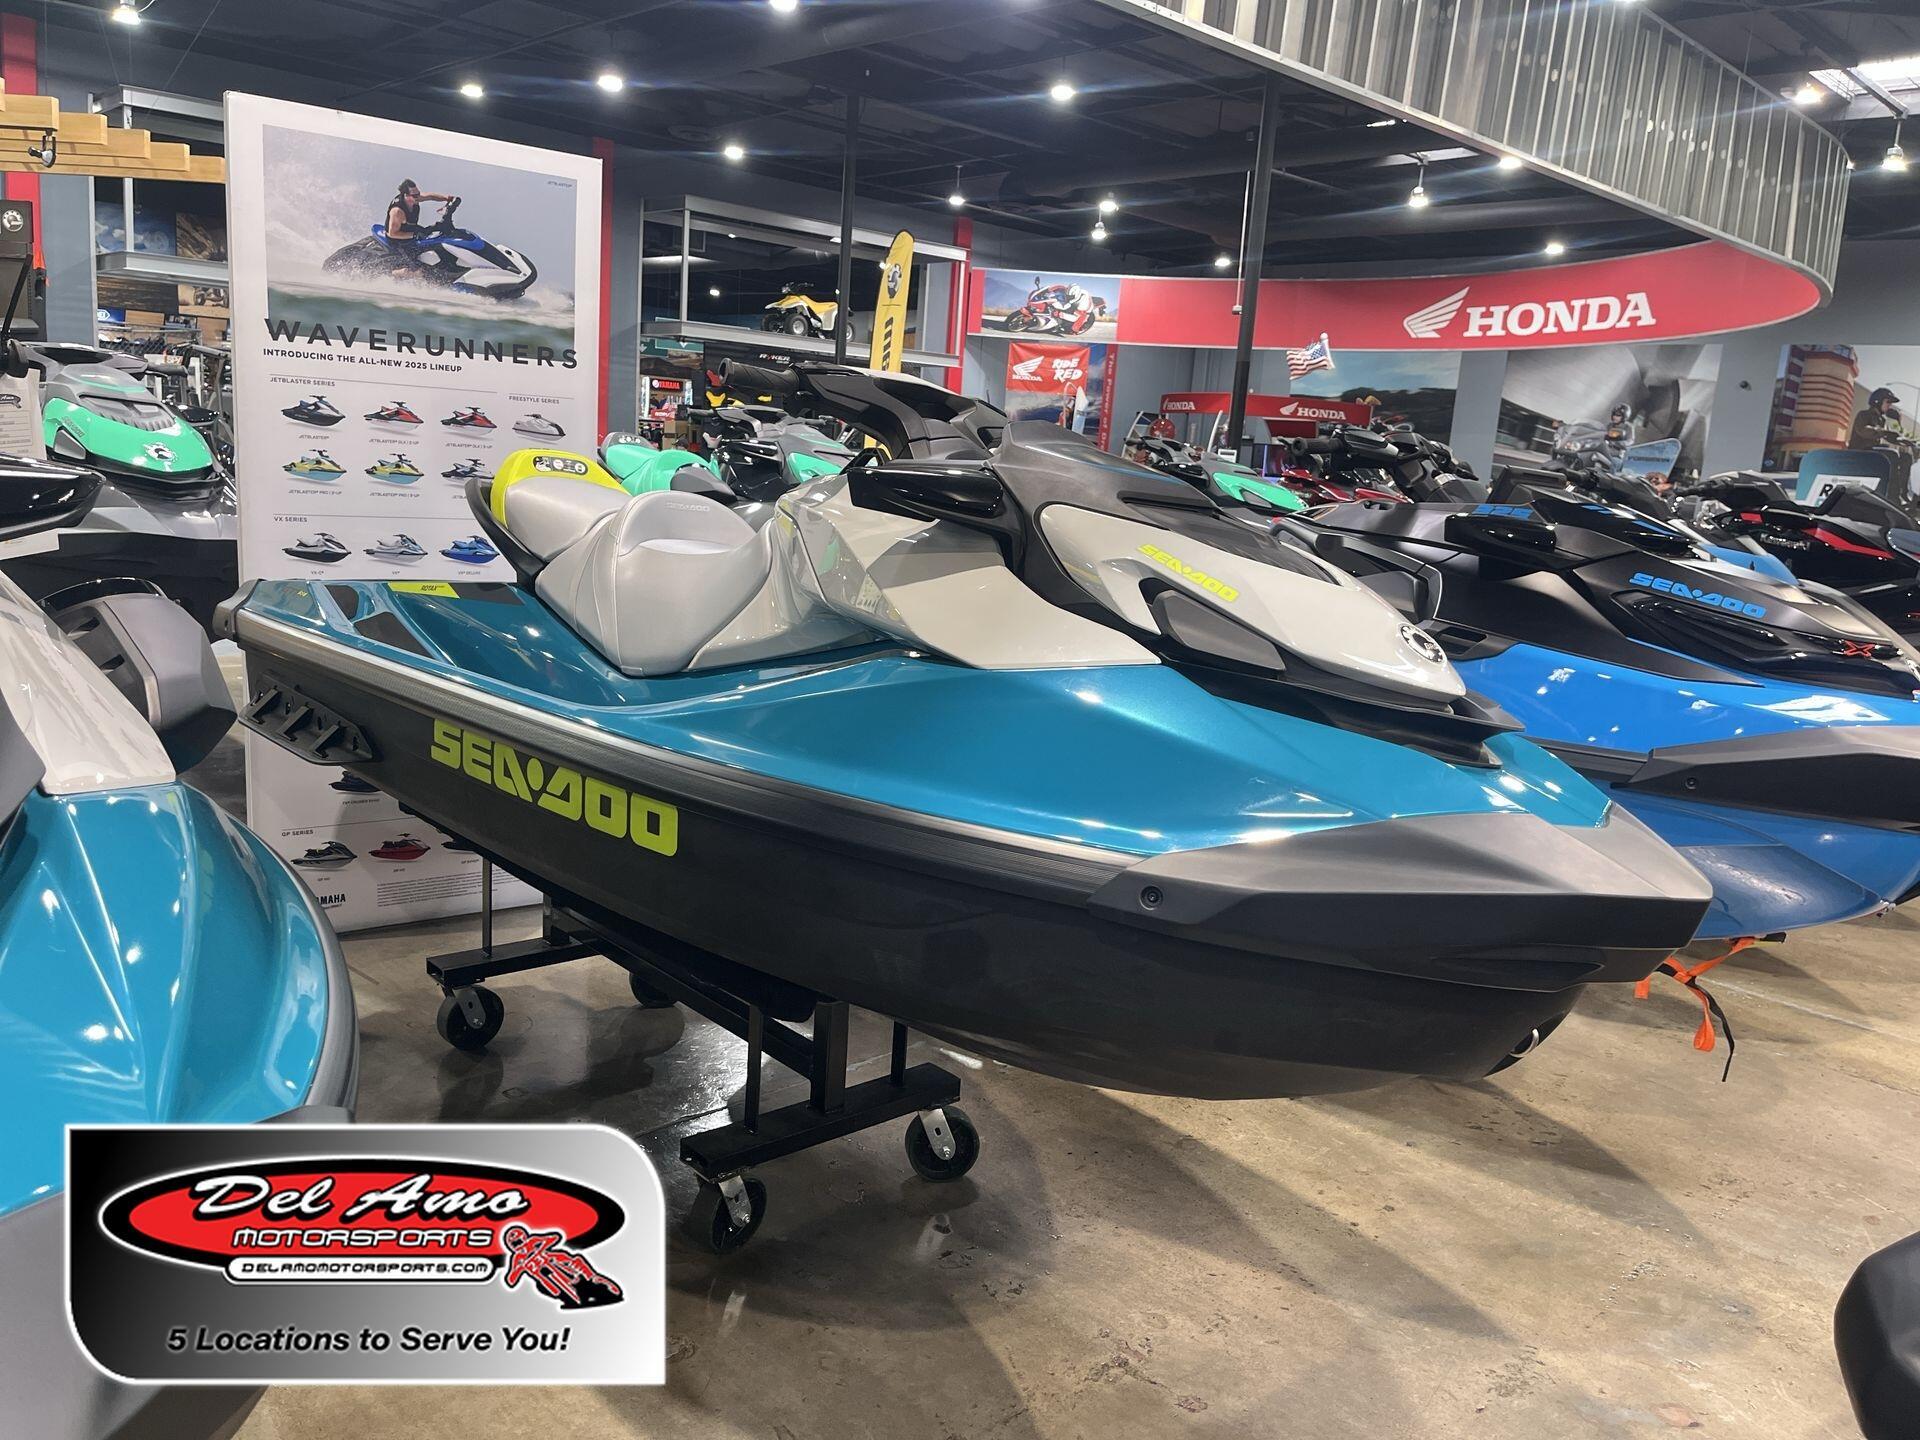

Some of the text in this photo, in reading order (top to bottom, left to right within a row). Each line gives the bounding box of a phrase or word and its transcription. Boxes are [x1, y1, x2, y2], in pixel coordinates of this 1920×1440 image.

[1463, 292, 1657, 337] HONDA
[264, 318, 578, 370] WAVERUNNERS
[263, 348, 462, 373] INTRODUCING THE ALL-NEW 2025 LINEUP
[1051, 358, 1080, 369] RIDE
[270, 377, 312, 385] JETBLASTER
[1012, 374, 1043, 382] HONDA
[1053, 368, 1084, 383] RED
[508, 395, 540, 403] FREESTYLE
[1297, 407, 1346, 420] HONDA
[317, 893, 346, 905] MAHA
